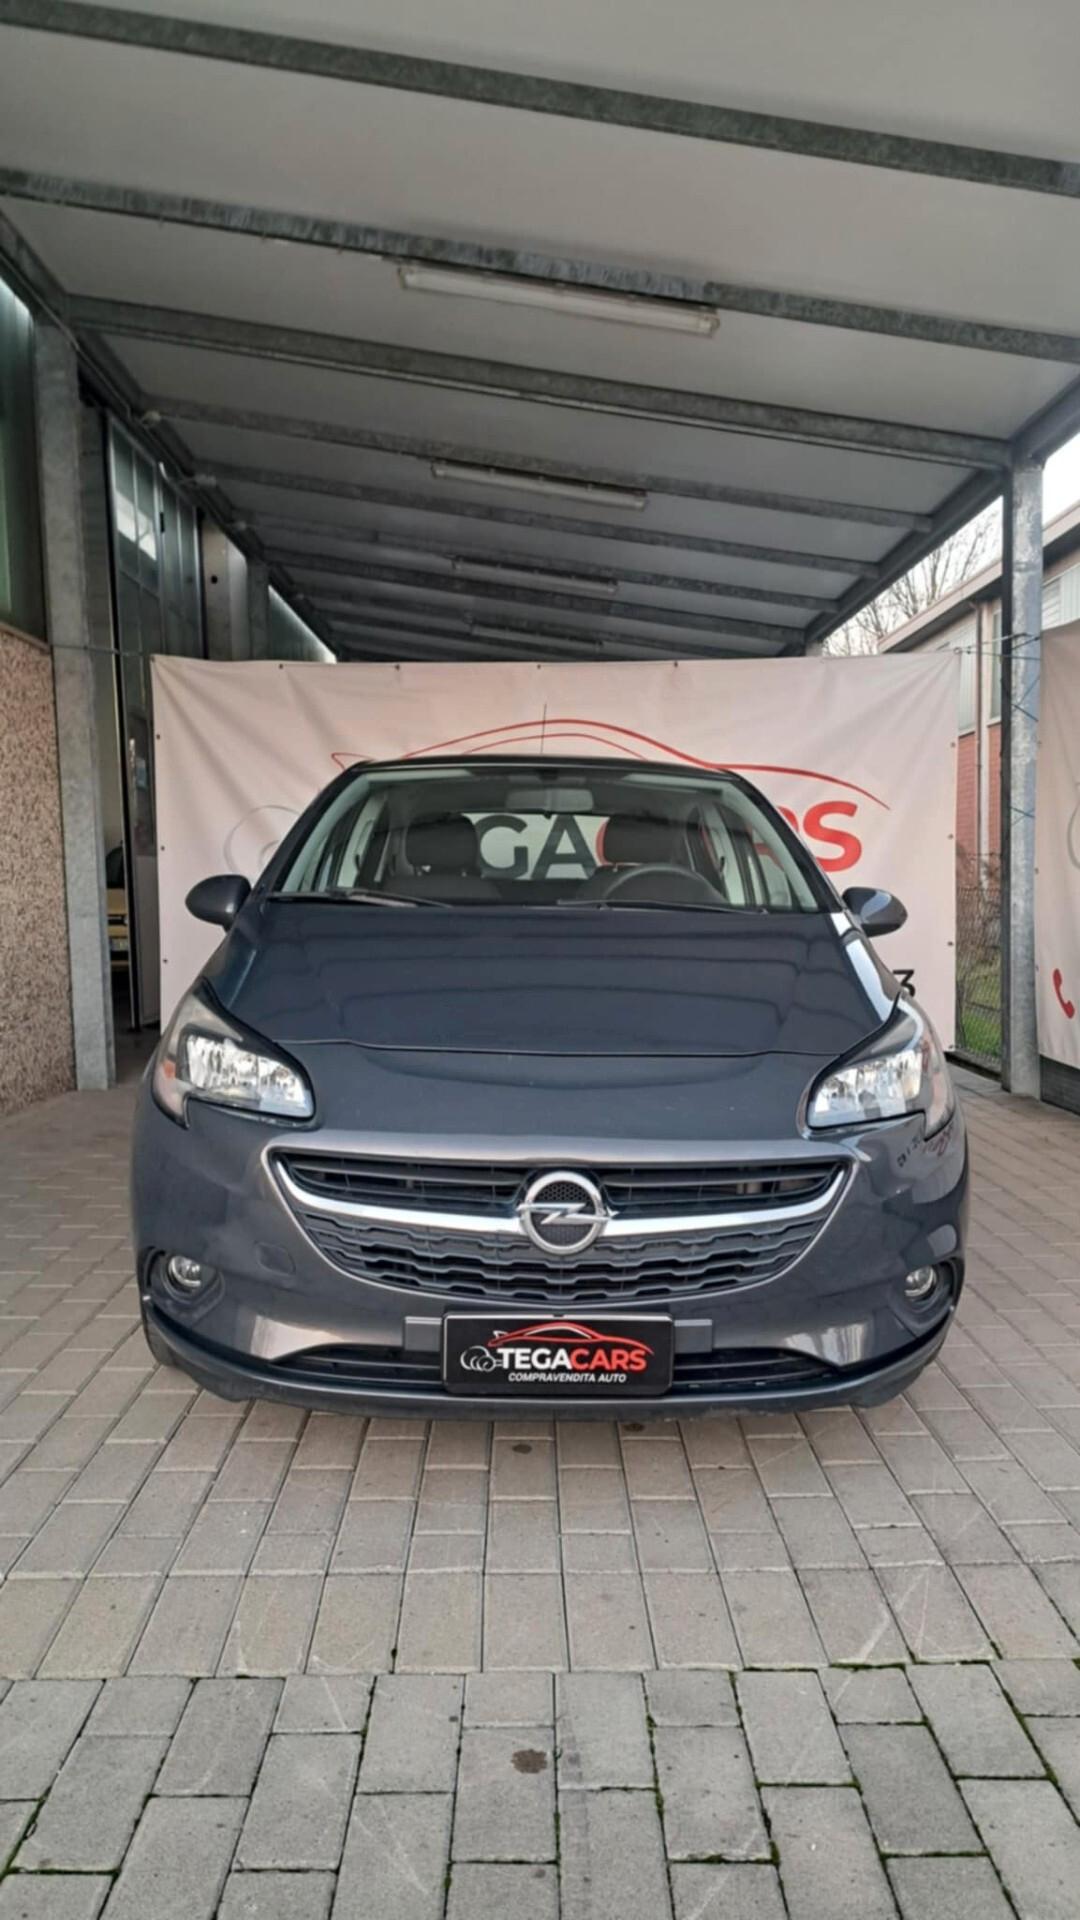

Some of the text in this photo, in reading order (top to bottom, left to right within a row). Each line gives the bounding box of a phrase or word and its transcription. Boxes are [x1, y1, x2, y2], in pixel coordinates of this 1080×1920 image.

[497, 1347, 647, 1371] TEGACARS
[508, 1371, 627, 1383] COMPRAVENDITA AUTO
